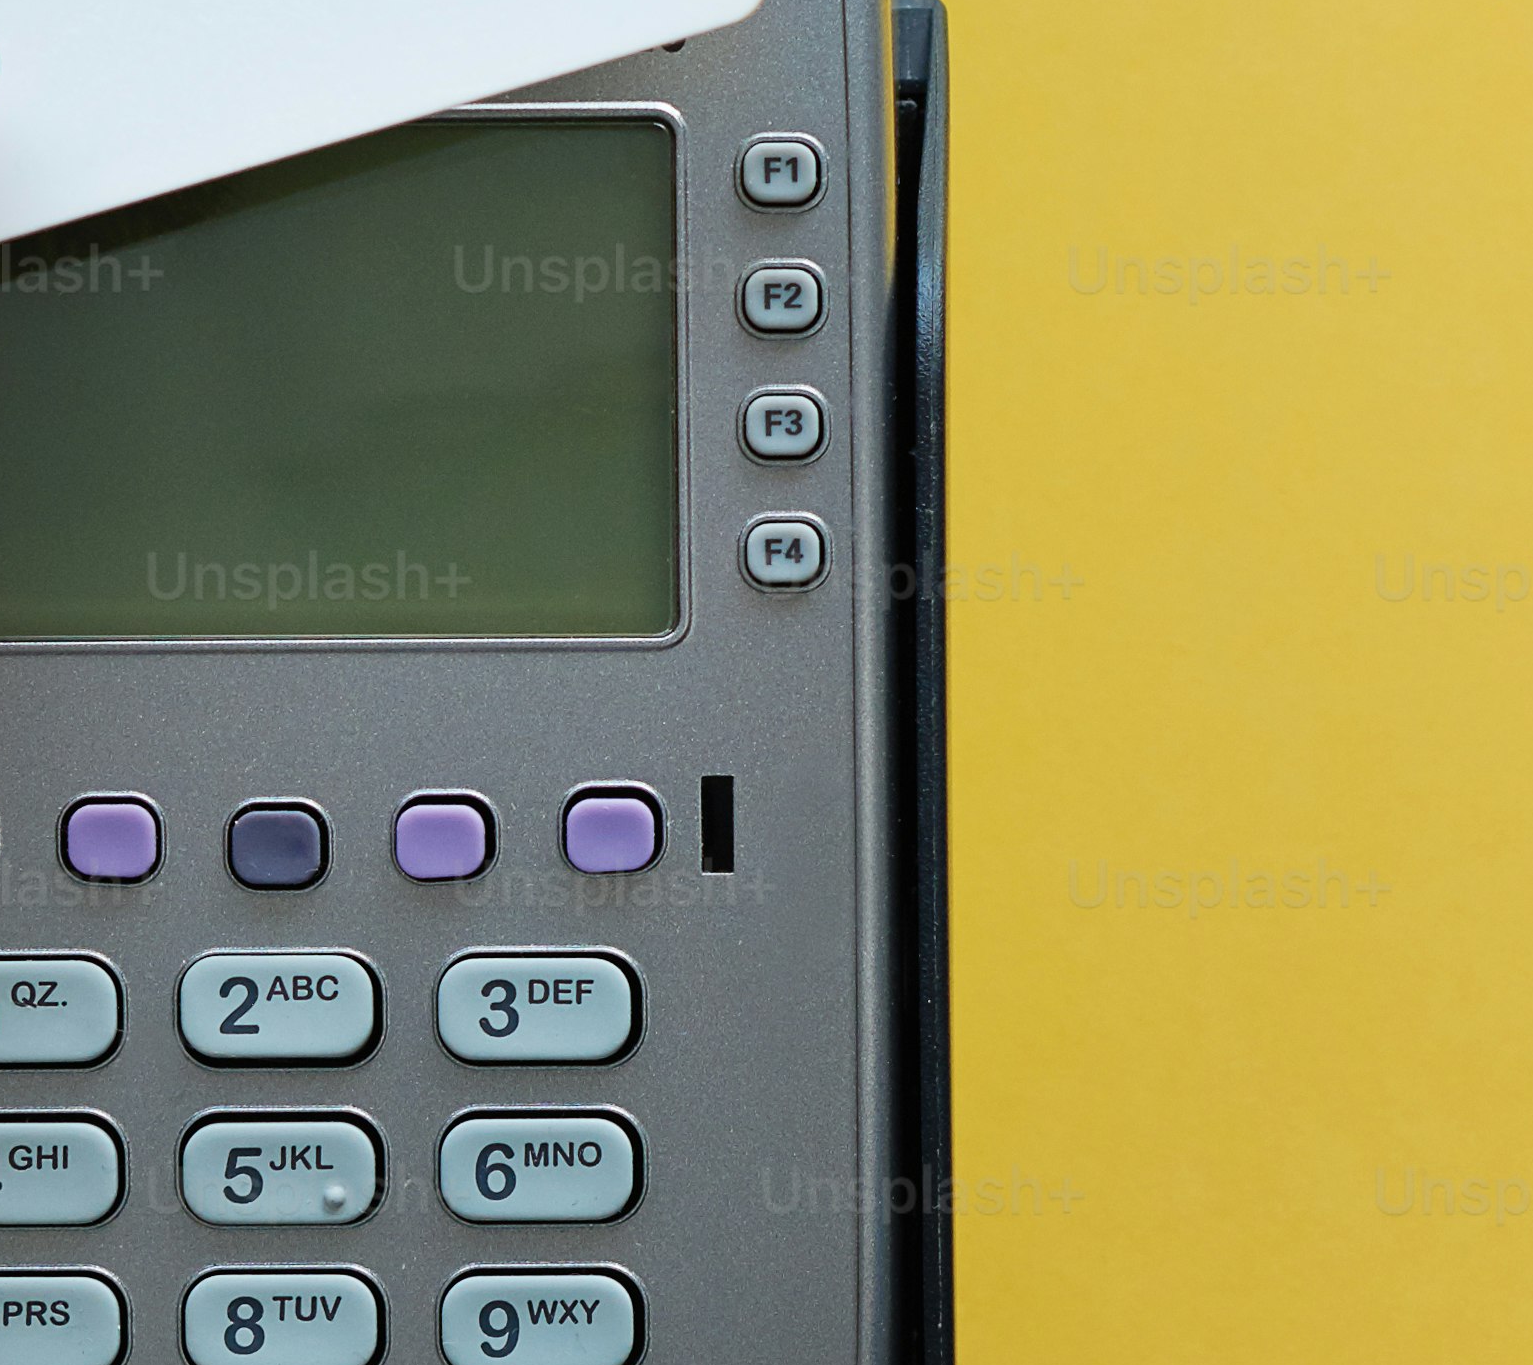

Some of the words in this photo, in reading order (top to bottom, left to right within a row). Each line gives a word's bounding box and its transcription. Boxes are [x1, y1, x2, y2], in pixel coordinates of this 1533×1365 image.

[763, 156, 799, 184] F1
[763, 282, 803, 310] F2
[764, 409, 803, 437] F3
[764, 537, 805, 566] F4
[10, 980, 68, 1009] QZ.
[219, 976, 260, 1035] 2
[265, 974, 339, 1002] ABC
[478, 978, 520, 1038] 3
[528, 978, 595, 1005] DEF
[8, 1144, 69, 1171] GHI
[475, 1142, 517, 1201] 6
[523, 1141, 603, 1168] MNO
[223, 1146, 264, 1205] 5
[269, 1144, 334, 1171] JKL
[2, 1299, 71, 1327] PRS
[223, 1295, 265, 1355] 8
[271, 1295, 343, 1322] TUV
[478, 1299, 520, 1359] 9
[526, 1298, 601, 1325] WXY
